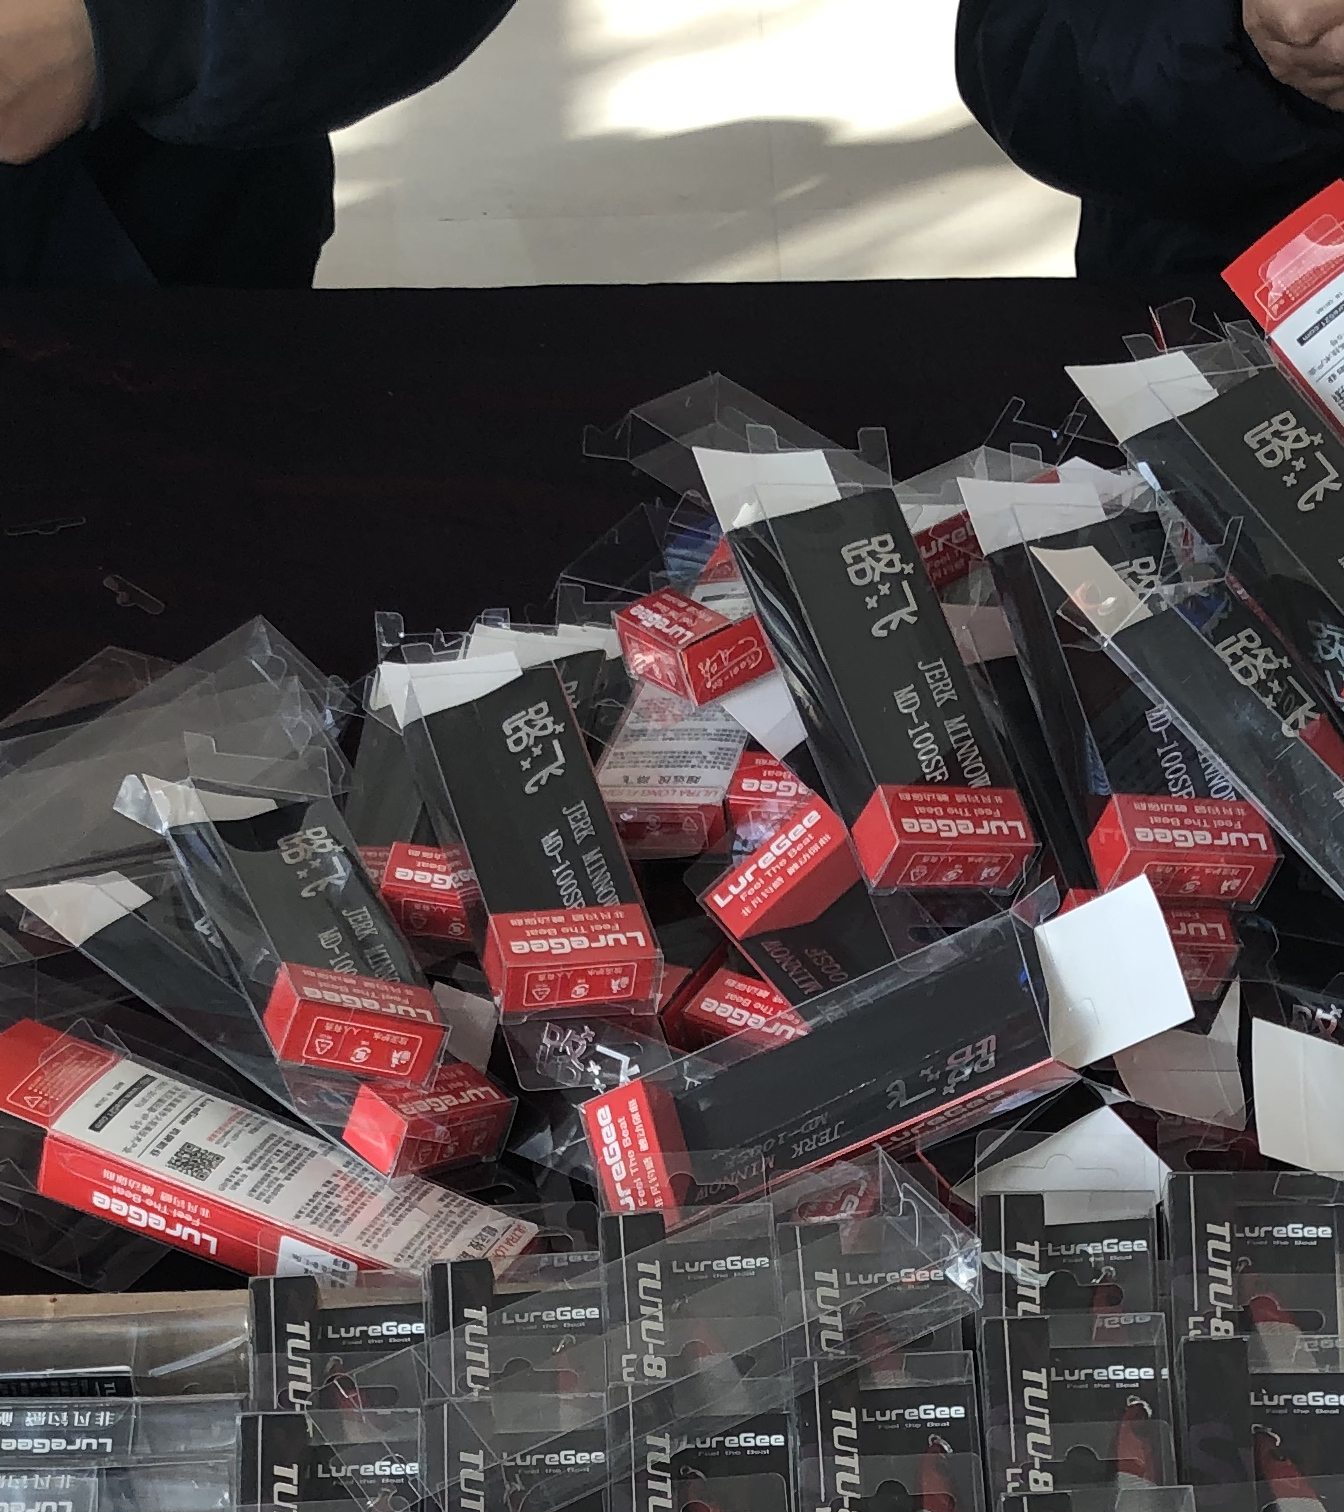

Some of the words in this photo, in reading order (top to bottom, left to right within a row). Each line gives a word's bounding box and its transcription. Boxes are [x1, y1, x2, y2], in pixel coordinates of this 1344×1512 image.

[894, 684, 949, 782] MD-100SF
[918, 658, 959, 708] JERK
[944, 714, 991, 789] MINNOW
[902, 818, 1025, 839] LureGee
[1134, 827, 1268, 851] LureGee
[562, 800, 596, 844] JERK
[582, 847, 620, 906] MINNOW
[712, 810, 821, 908] LureGee
[541, 829, 586, 909] MD-100SF
[342, 906, 378, 940] JERK
[510, 931, 646, 954] LureGee
[303, 986, 433, 1022] LureGee
[92, 1191, 218, 1255] LureGee
[1234, 1224, 1332, 1238] LureGee
[1048, 1239, 1147, 1256] LureGee
[672, 1256, 769, 1272] LureGee
[845, 1268, 944, 1285] LureGee
[502, 1307, 599, 1324] LureGee
[327, 1322, 425, 1338] LureGee
[1051, 1365, 1155, 1381] LureGee
[862, 1405, 965, 1421] LureGee
[1, 1437, 113, 1454] LureGee
[501, 1450, 605, 1466] LureGee
[317, 1462, 419, 1478] LureGee
